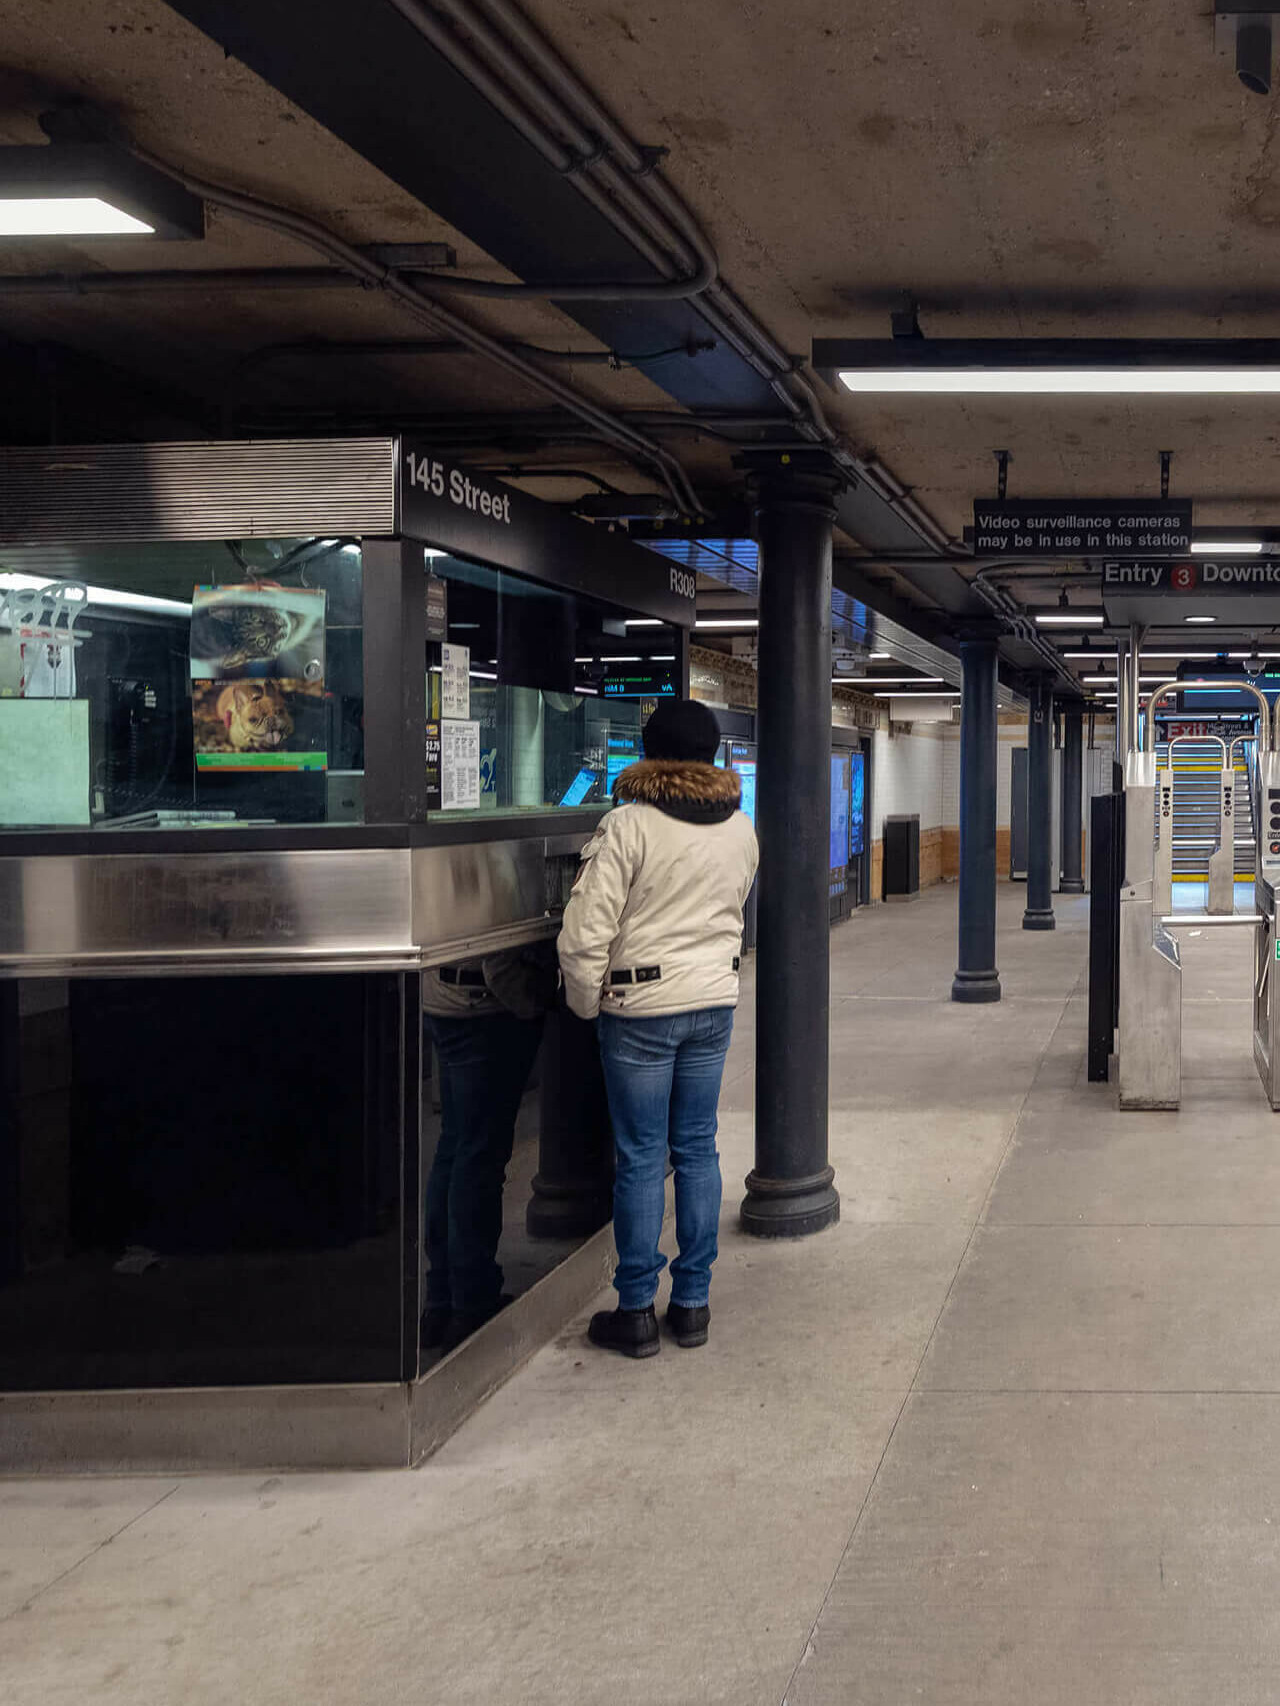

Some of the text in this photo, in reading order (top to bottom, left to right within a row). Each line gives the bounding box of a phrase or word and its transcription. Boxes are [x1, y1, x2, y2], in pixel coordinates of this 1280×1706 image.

[406, 452, 511, 524] 145 Street
[978, 515, 1181, 529] Video surveillance cameras
[978, 533, 1189, 549] may be in use in this station
[669, 567, 696, 600] R308
[1104, 563, 1163, 585] Entry
[1177, 569, 1190, 585] 3
[1168, 722, 1206, 738] Exit
